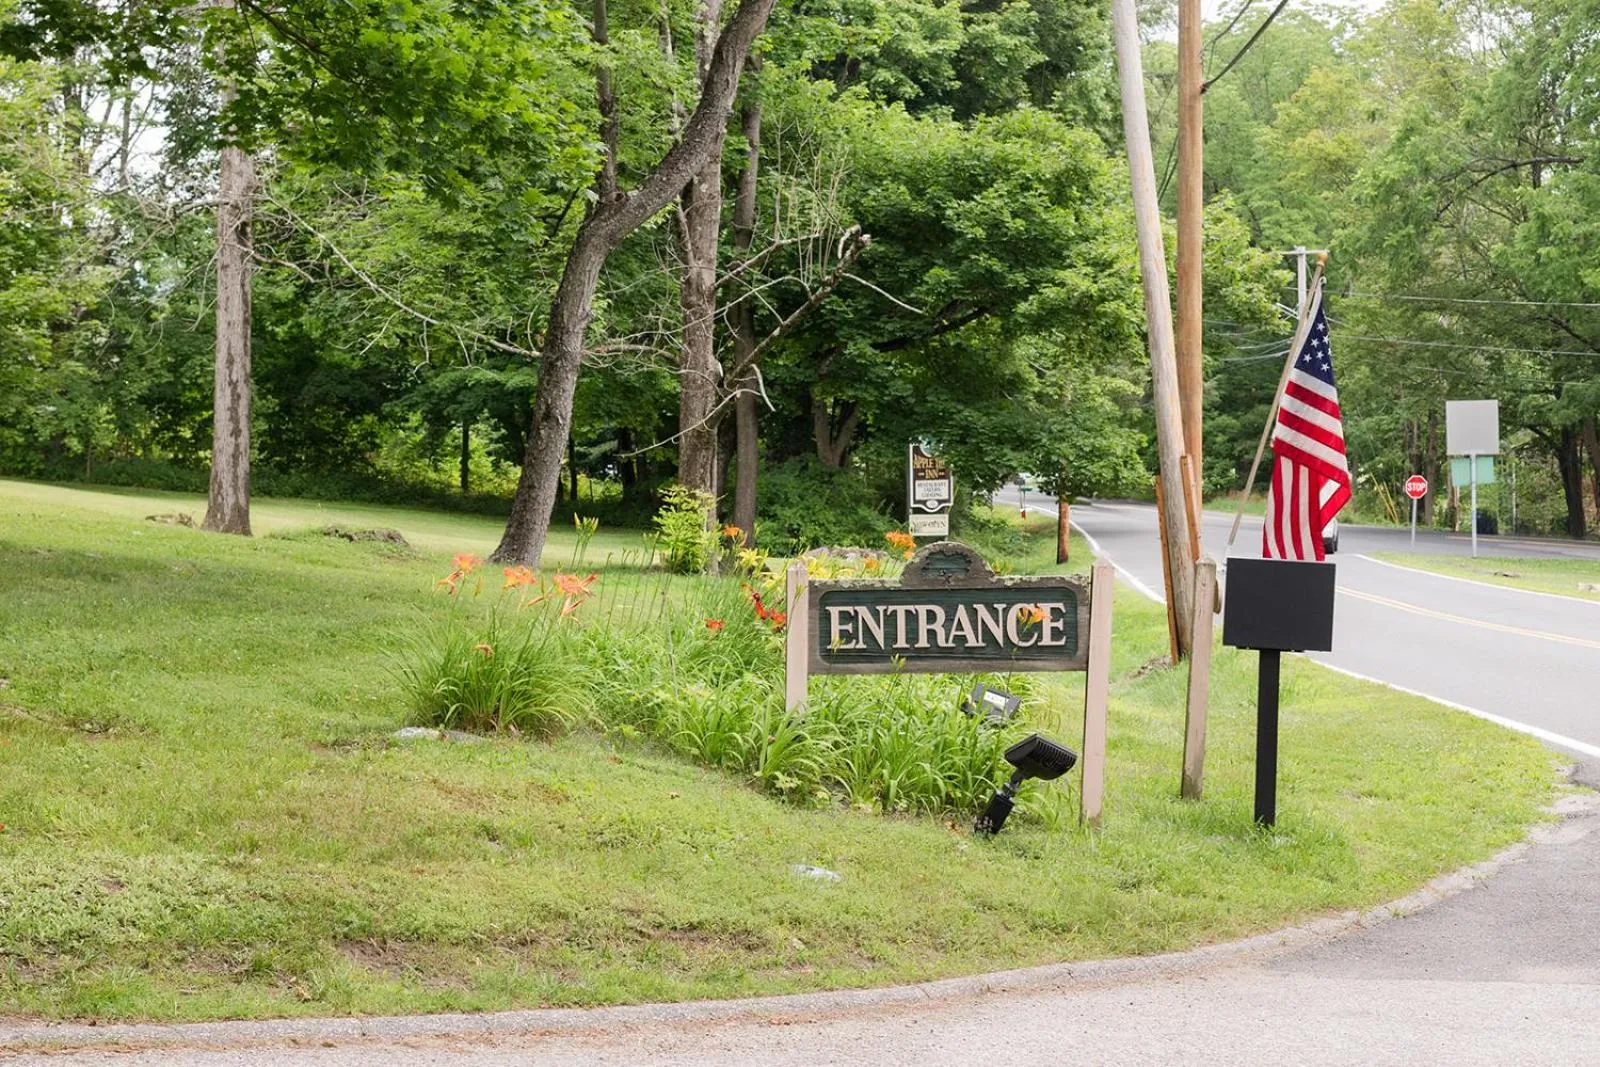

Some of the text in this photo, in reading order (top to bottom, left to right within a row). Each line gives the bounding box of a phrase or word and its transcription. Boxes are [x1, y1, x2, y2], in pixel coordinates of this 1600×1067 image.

[925, 469, 939, 479] INN
[1407, 482, 1426, 492] STOP
[825, 602, 1067, 650] ENTRANCE
